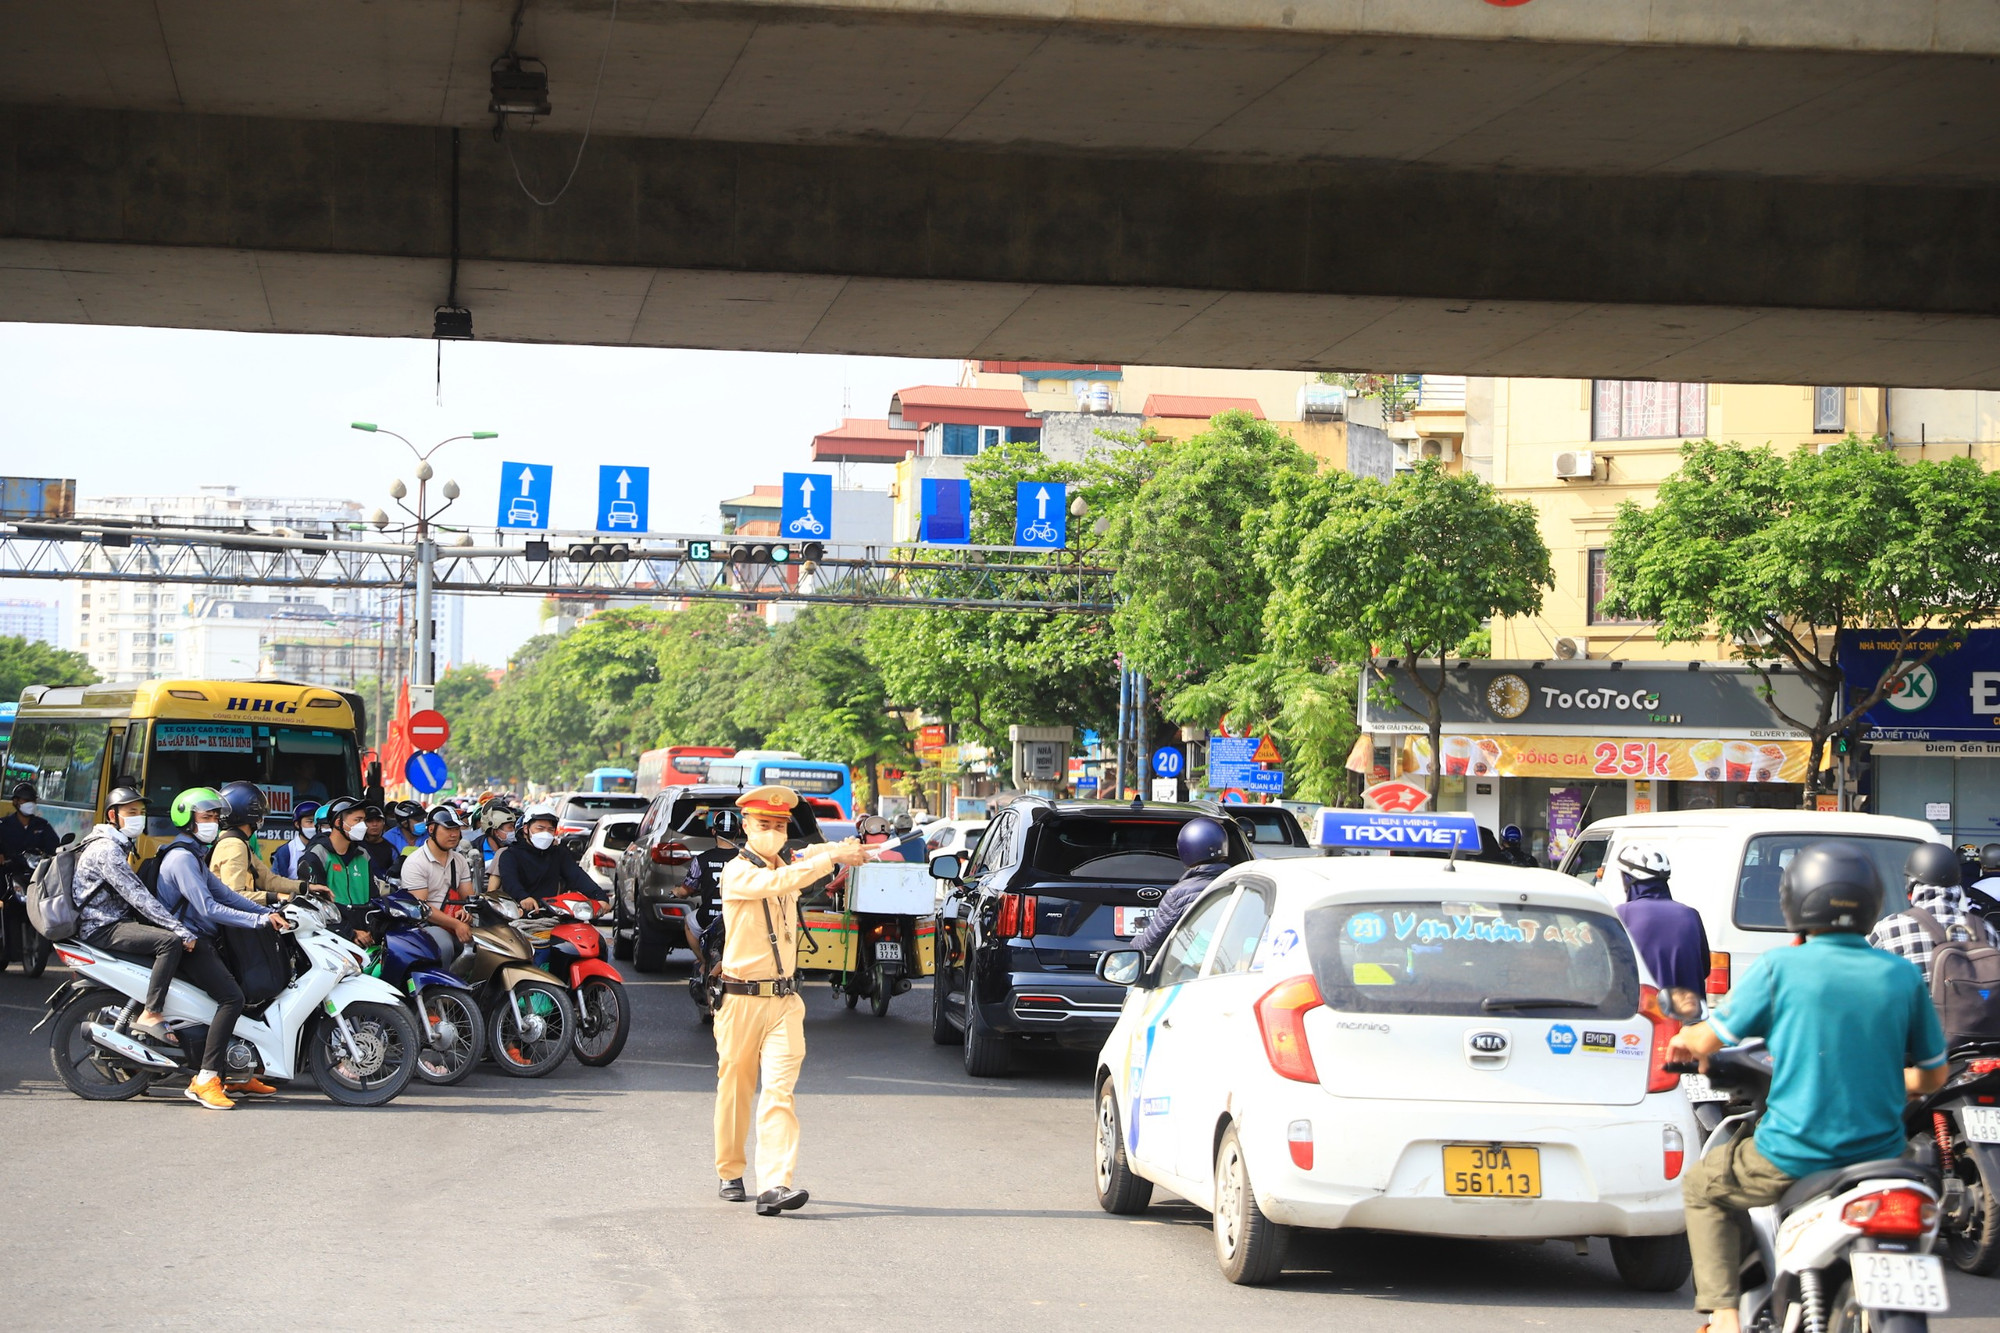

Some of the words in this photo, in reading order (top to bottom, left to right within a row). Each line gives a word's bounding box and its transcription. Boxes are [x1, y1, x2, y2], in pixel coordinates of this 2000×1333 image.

[691, 543, 710, 559] 06
[225, 697, 298, 714] HHG
[1648, 713, 1667, 722] Tea
[1158, 752, 1178, 772] 20
[1516, 748, 1559, 765] ĐỒNG
[1594, 741, 1671, 776] 25k
[262, 786, 291, 812] ÌNH
[1369, 817, 1399, 825] LIEN
[1403, 818, 1438, 827] MINH
[267, 829, 281, 840] BX
[1341, 825, 1404, 843] TAXI
[1407, 828, 1468, 844] VIET
[1353, 917, 1382, 937] 231
[1336, 1021, 1391, 1032] morning
[1475, 1037, 1503, 1049] KIA
[1550, 1029, 1573, 1044] be
[1585, 1033, 1613, 1044] EMDI
[1471, 1149, 1512, 1170] 30A
[1455, 1171, 1530, 1194] 561.13
